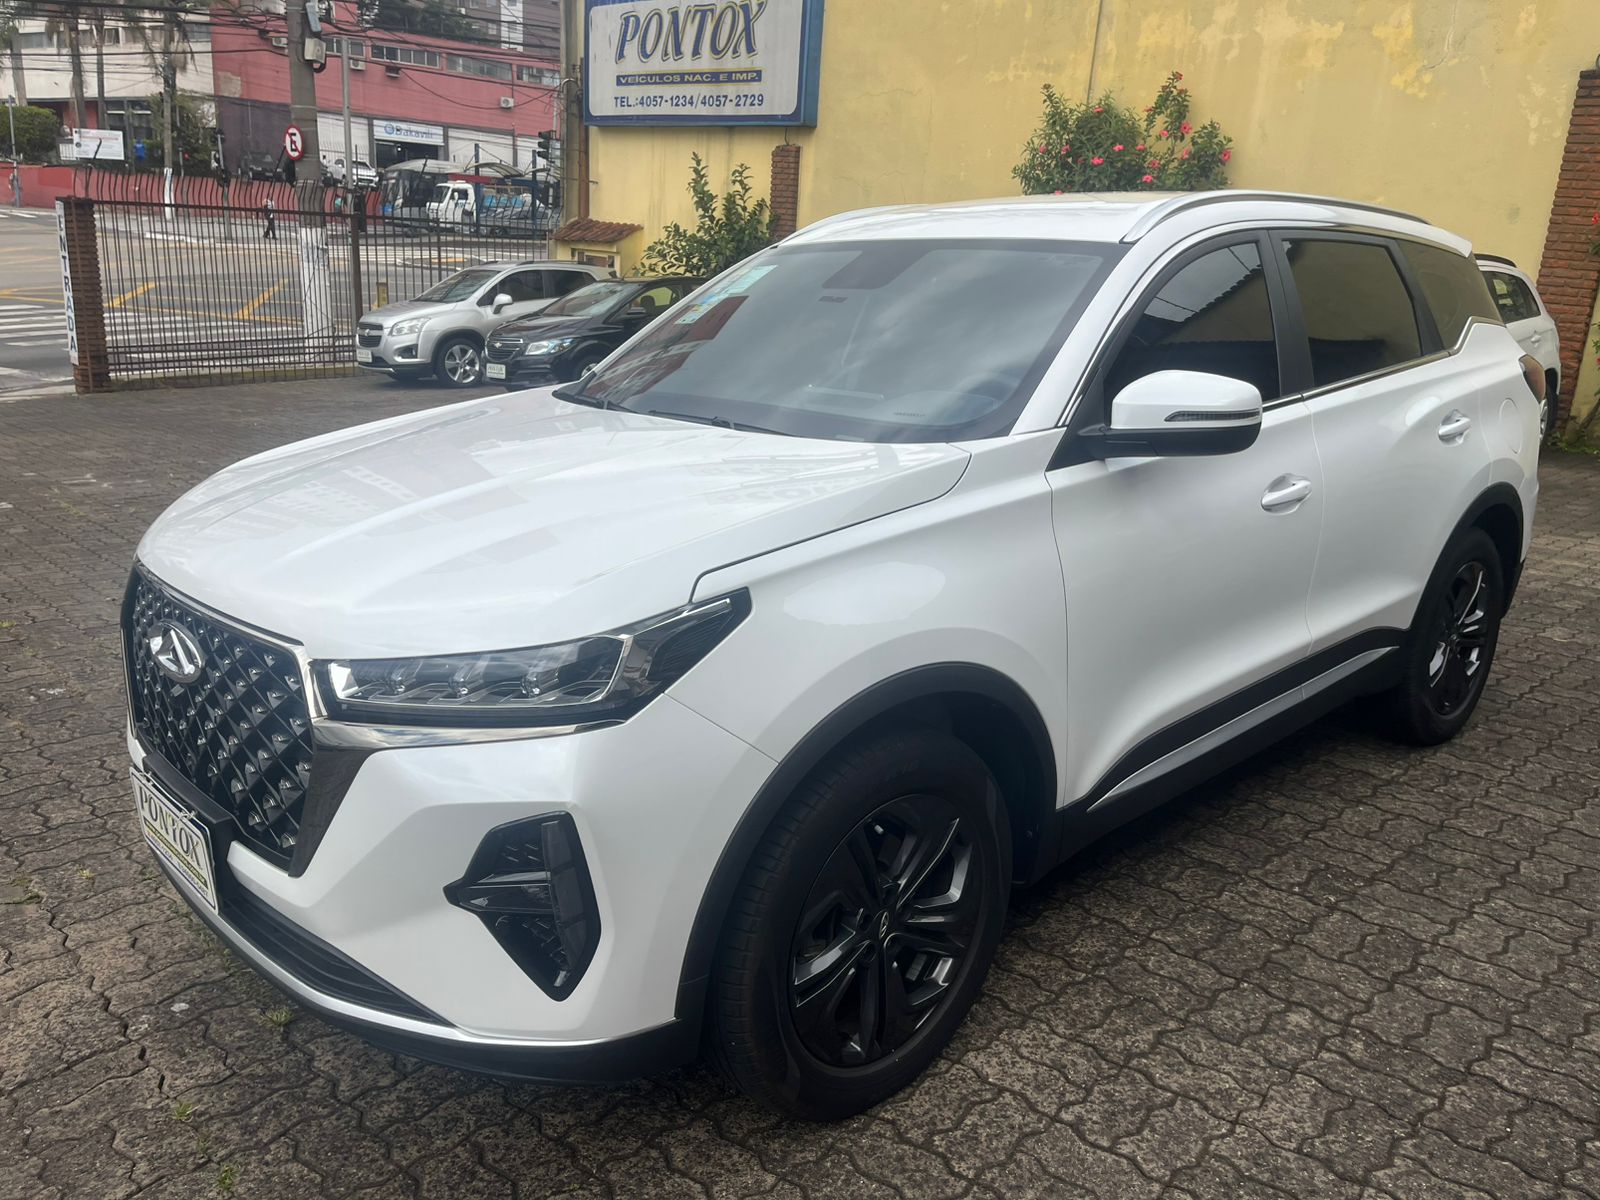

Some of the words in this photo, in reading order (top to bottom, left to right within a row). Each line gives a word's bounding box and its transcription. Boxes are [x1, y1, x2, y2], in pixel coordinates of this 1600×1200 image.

[615, 0, 768, 64] PONTOX
[684, 73, 716, 82] NAC.
[719, 73, 729, 81] E
[732, 72, 759, 81] IMP.
[58, 214, 77, 353] ENTRADA
[138, 784, 203, 870] PONTOX
